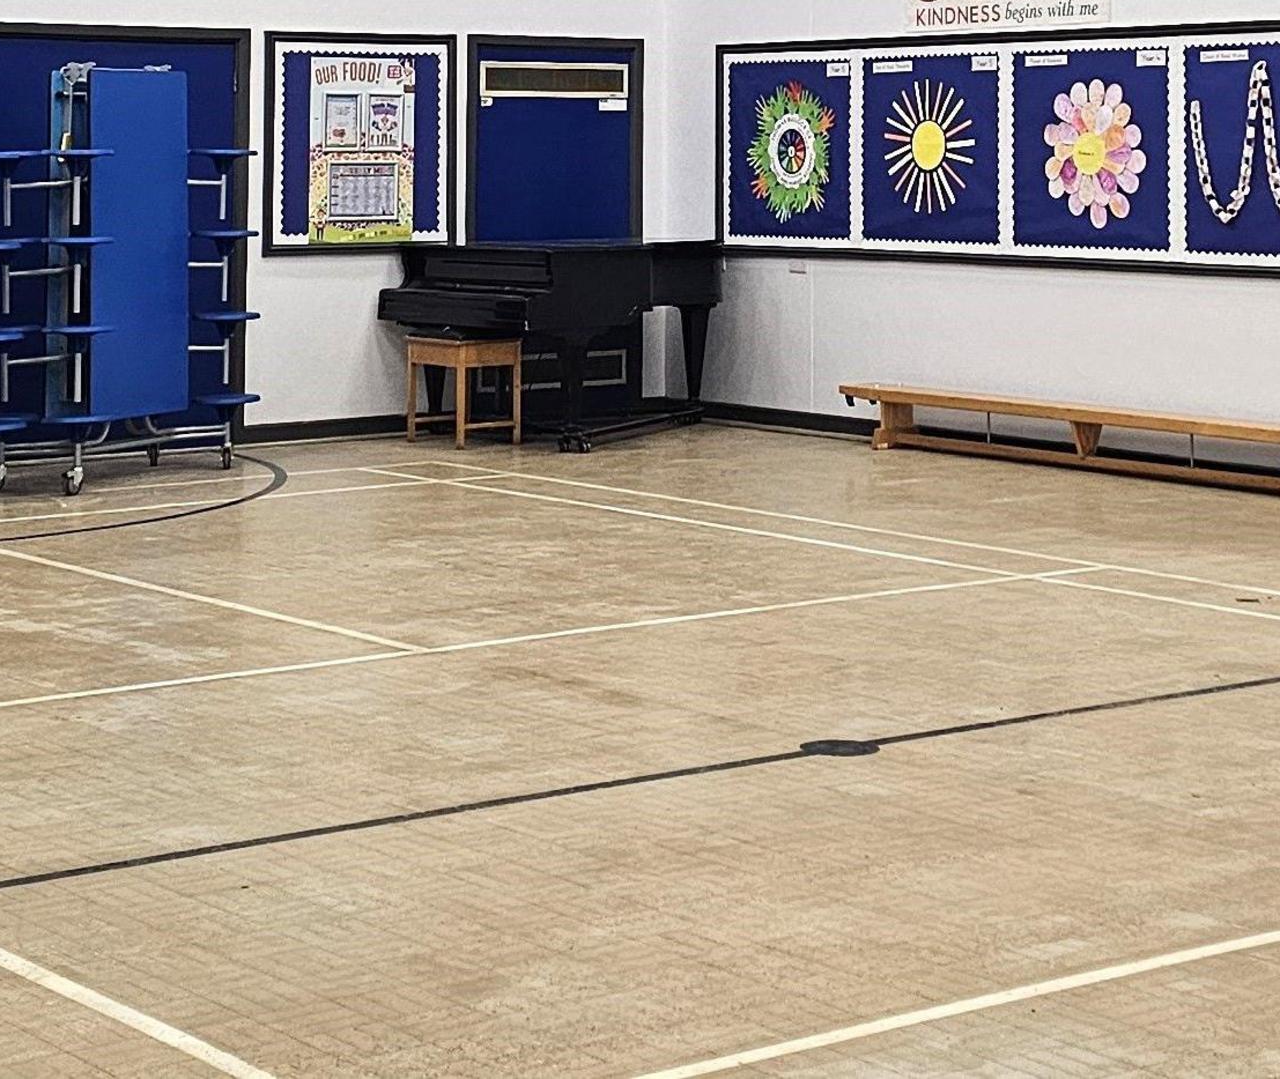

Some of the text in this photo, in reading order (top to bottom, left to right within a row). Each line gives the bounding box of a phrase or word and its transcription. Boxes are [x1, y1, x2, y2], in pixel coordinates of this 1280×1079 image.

[916, 4, 1001, 26] KINDNESS
[1005, 1, 1043, 23] begins
[1079, 3, 1099, 16] me
[315, 65, 338, 85] OUR
[343, 62, 382, 84] FOOD!
